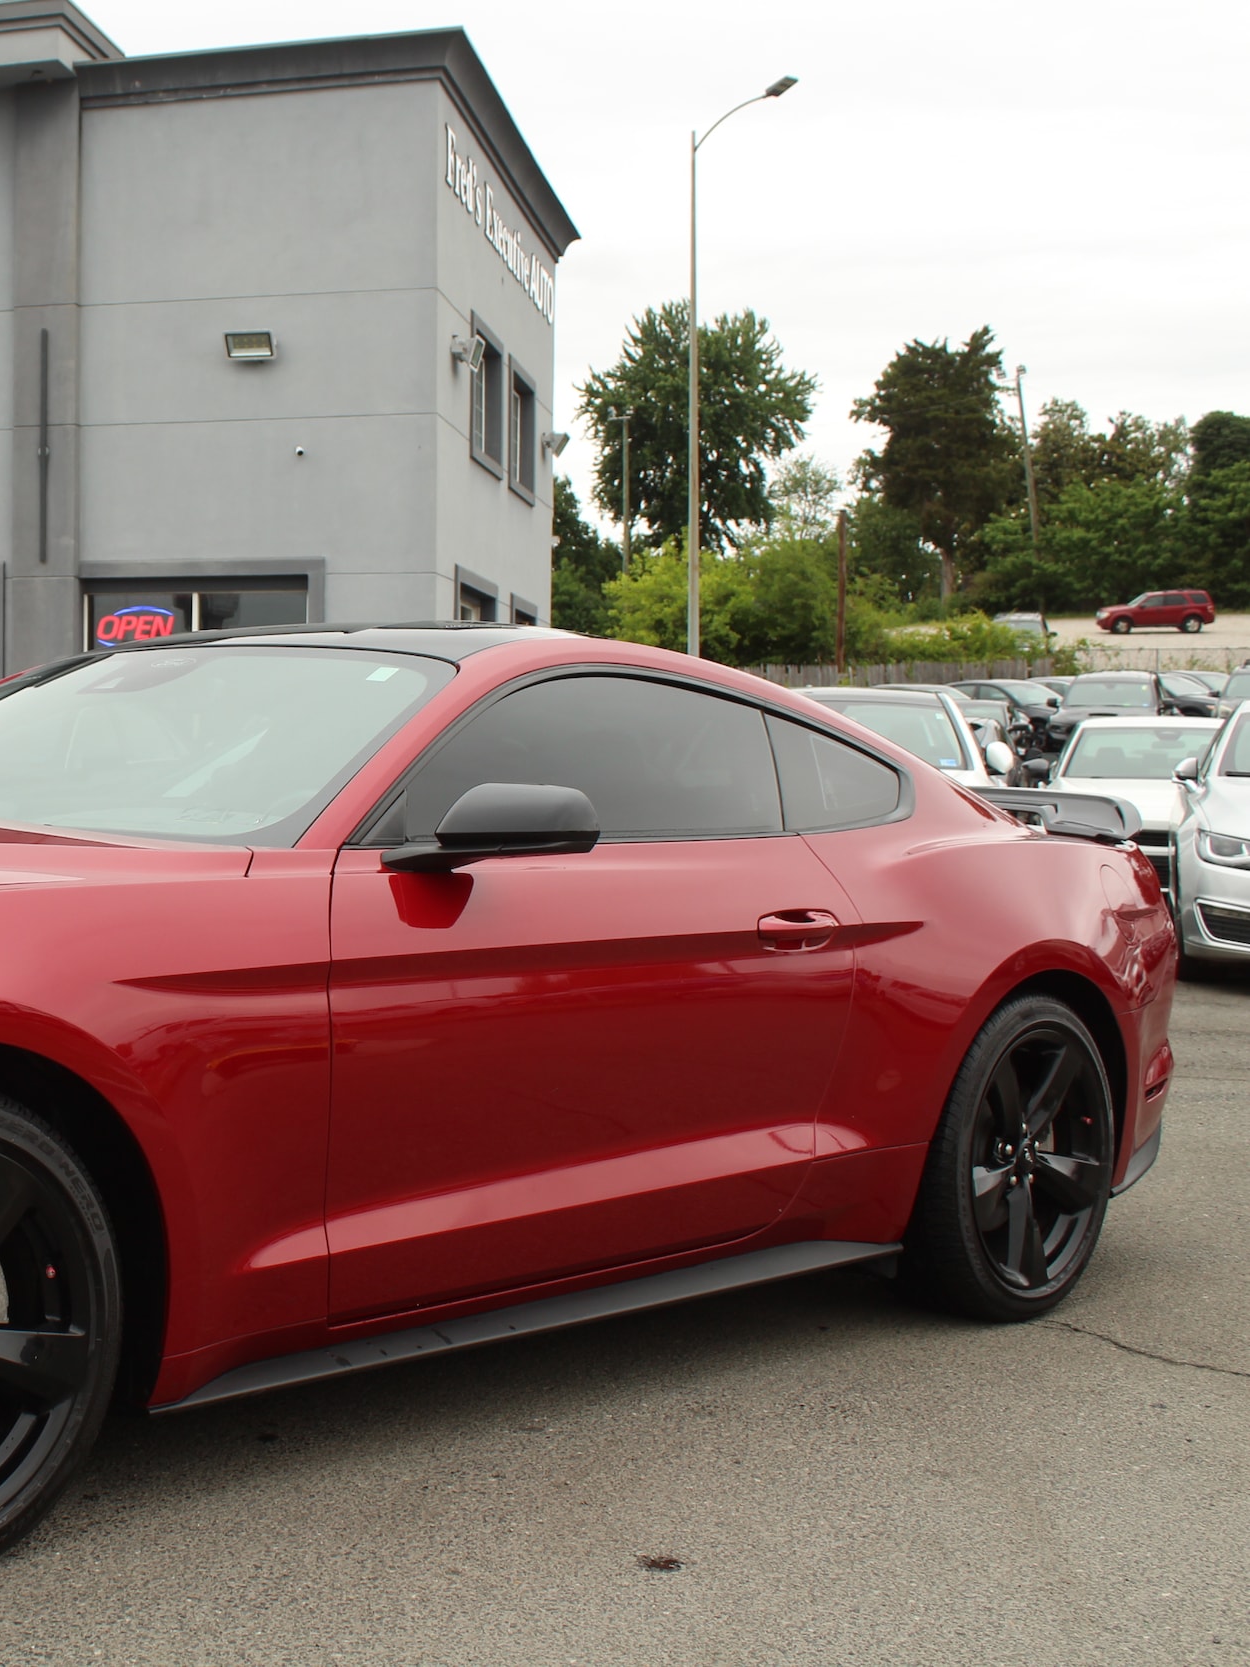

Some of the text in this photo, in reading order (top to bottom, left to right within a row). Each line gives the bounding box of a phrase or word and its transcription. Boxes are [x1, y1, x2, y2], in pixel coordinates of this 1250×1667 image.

[445, 122, 555, 326] Fred's Executive AUTO
[96, 615, 175, 640] OPEN
[59, 1160, 104, 1231] NERO
